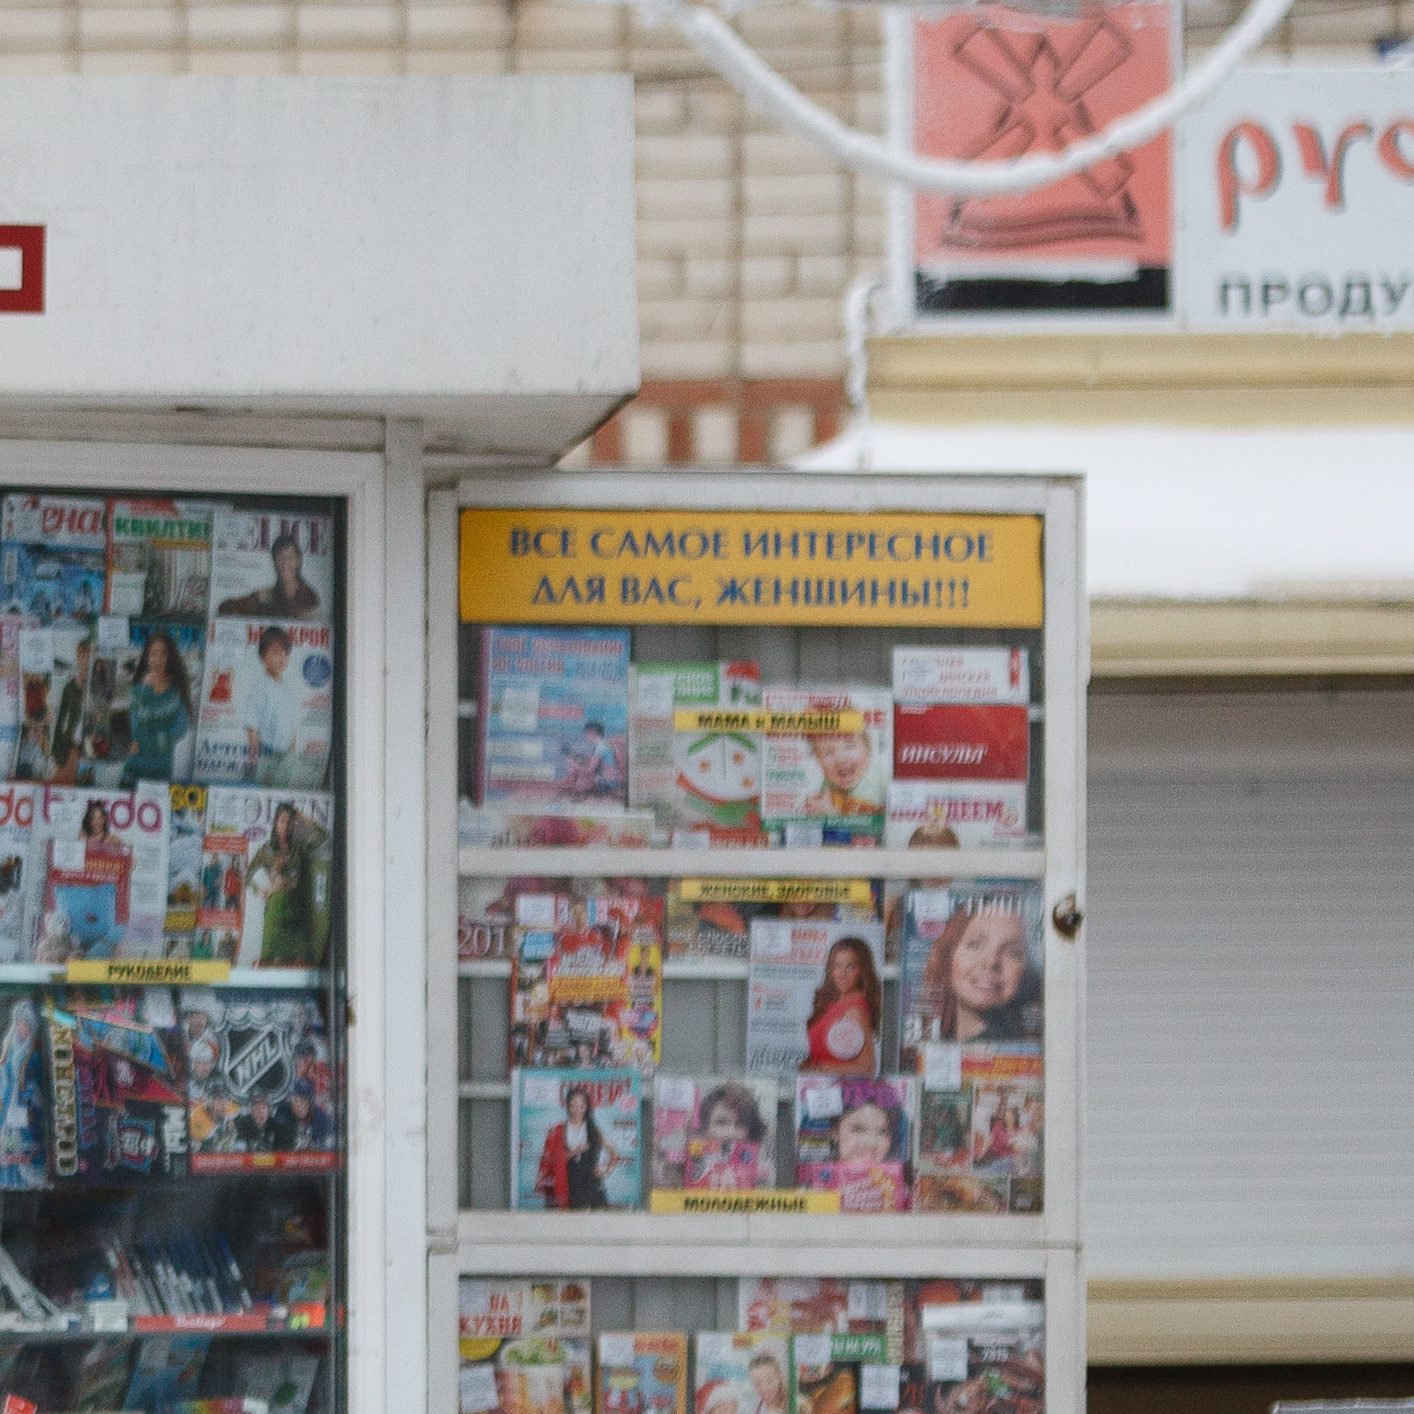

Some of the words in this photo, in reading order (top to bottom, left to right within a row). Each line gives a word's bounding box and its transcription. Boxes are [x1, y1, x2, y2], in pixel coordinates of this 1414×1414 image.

[509, 527, 574, 559] ВСЕ
[589, 527, 729, 560] САМОЕ
[743, 530, 994, 563] ИНТЕРЕСНОЕ
[532, 574, 606, 606] ДЛЯ
[621, 575, 702, 610] ВАС,
[716, 576, 971, 609] ЖЕНЩИНЫ!!!
[235, 1035, 278, 1086] NHL
